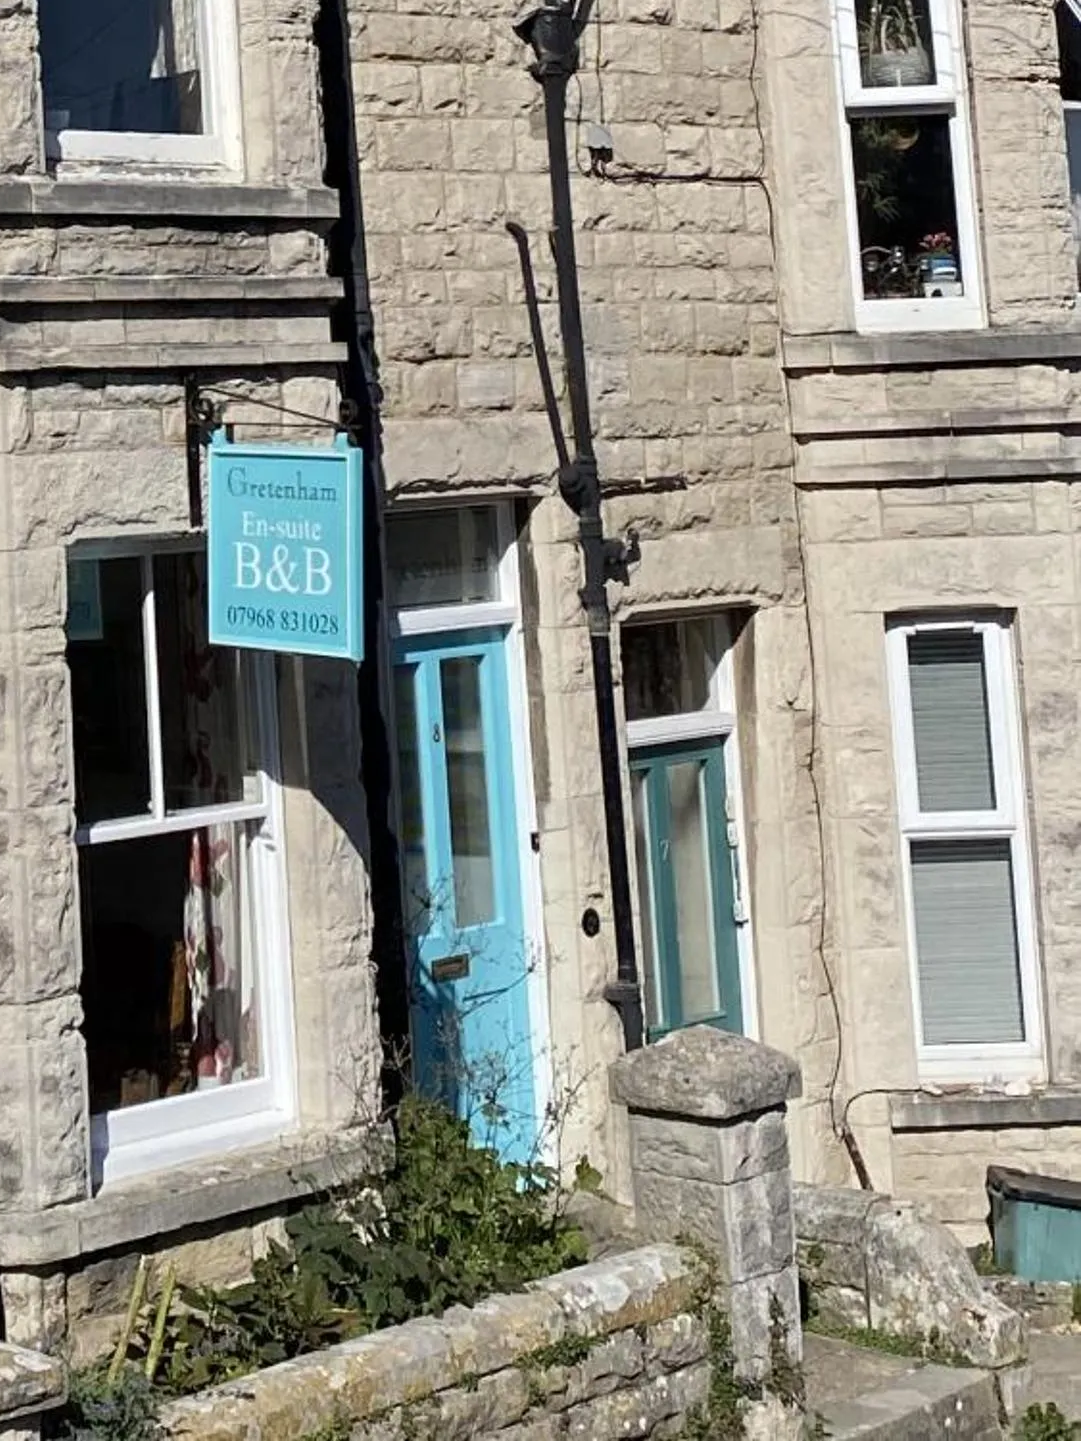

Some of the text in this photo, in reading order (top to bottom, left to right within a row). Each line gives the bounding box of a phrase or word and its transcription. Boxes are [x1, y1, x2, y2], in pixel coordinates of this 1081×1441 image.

[227, 465, 337, 502] Gretenham
[242, 510, 322, 540] En-suite
[233, 541, 332, 596] B&B
[227, 606, 339, 635] 07968 831028
[433, 722, 441, 743] 8
